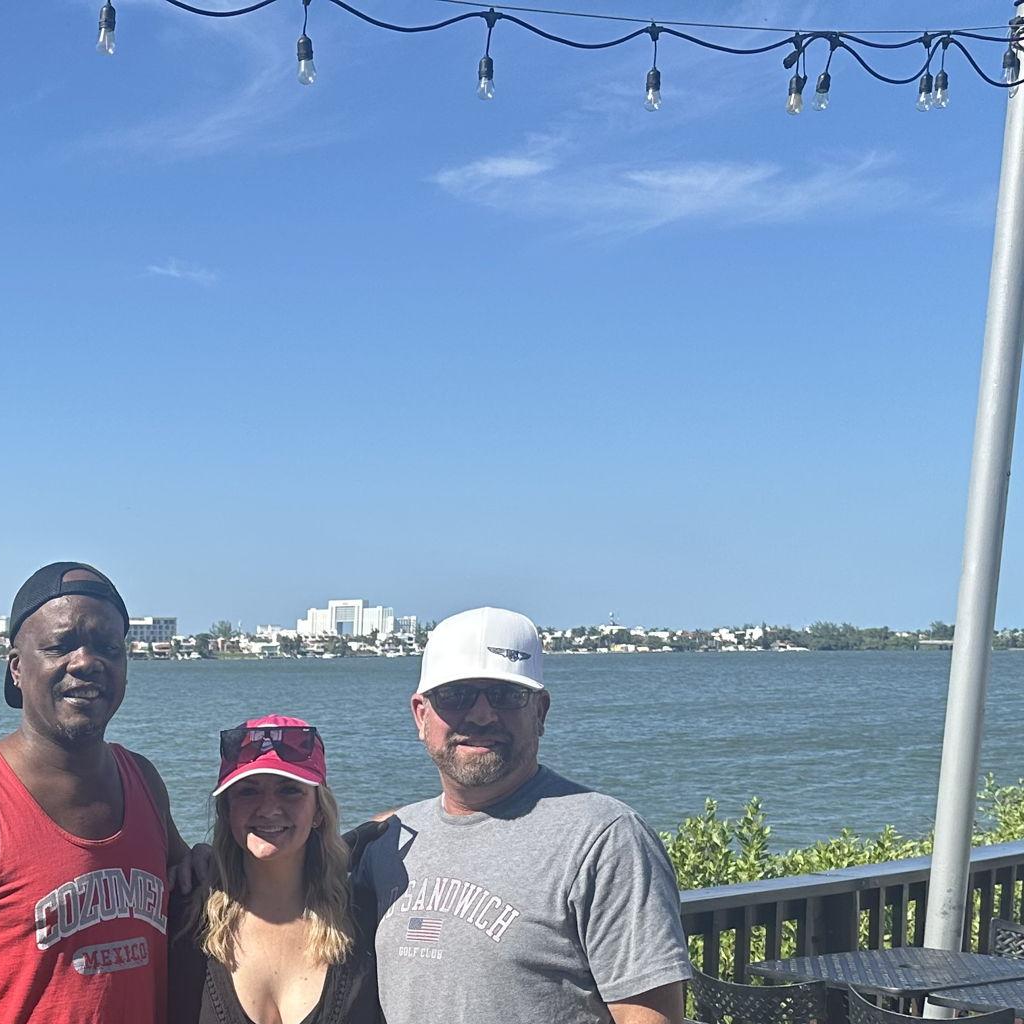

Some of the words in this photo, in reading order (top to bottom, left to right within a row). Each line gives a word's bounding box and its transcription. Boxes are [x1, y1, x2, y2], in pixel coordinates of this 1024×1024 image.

[35, 868, 168, 950] COZUMEL
[400, 877, 521, 943] SANDWICH
[82, 943, 147, 969] MEXICO
[398, 946, 419, 957] GOLF
[420, 947, 443, 959] CLUB
